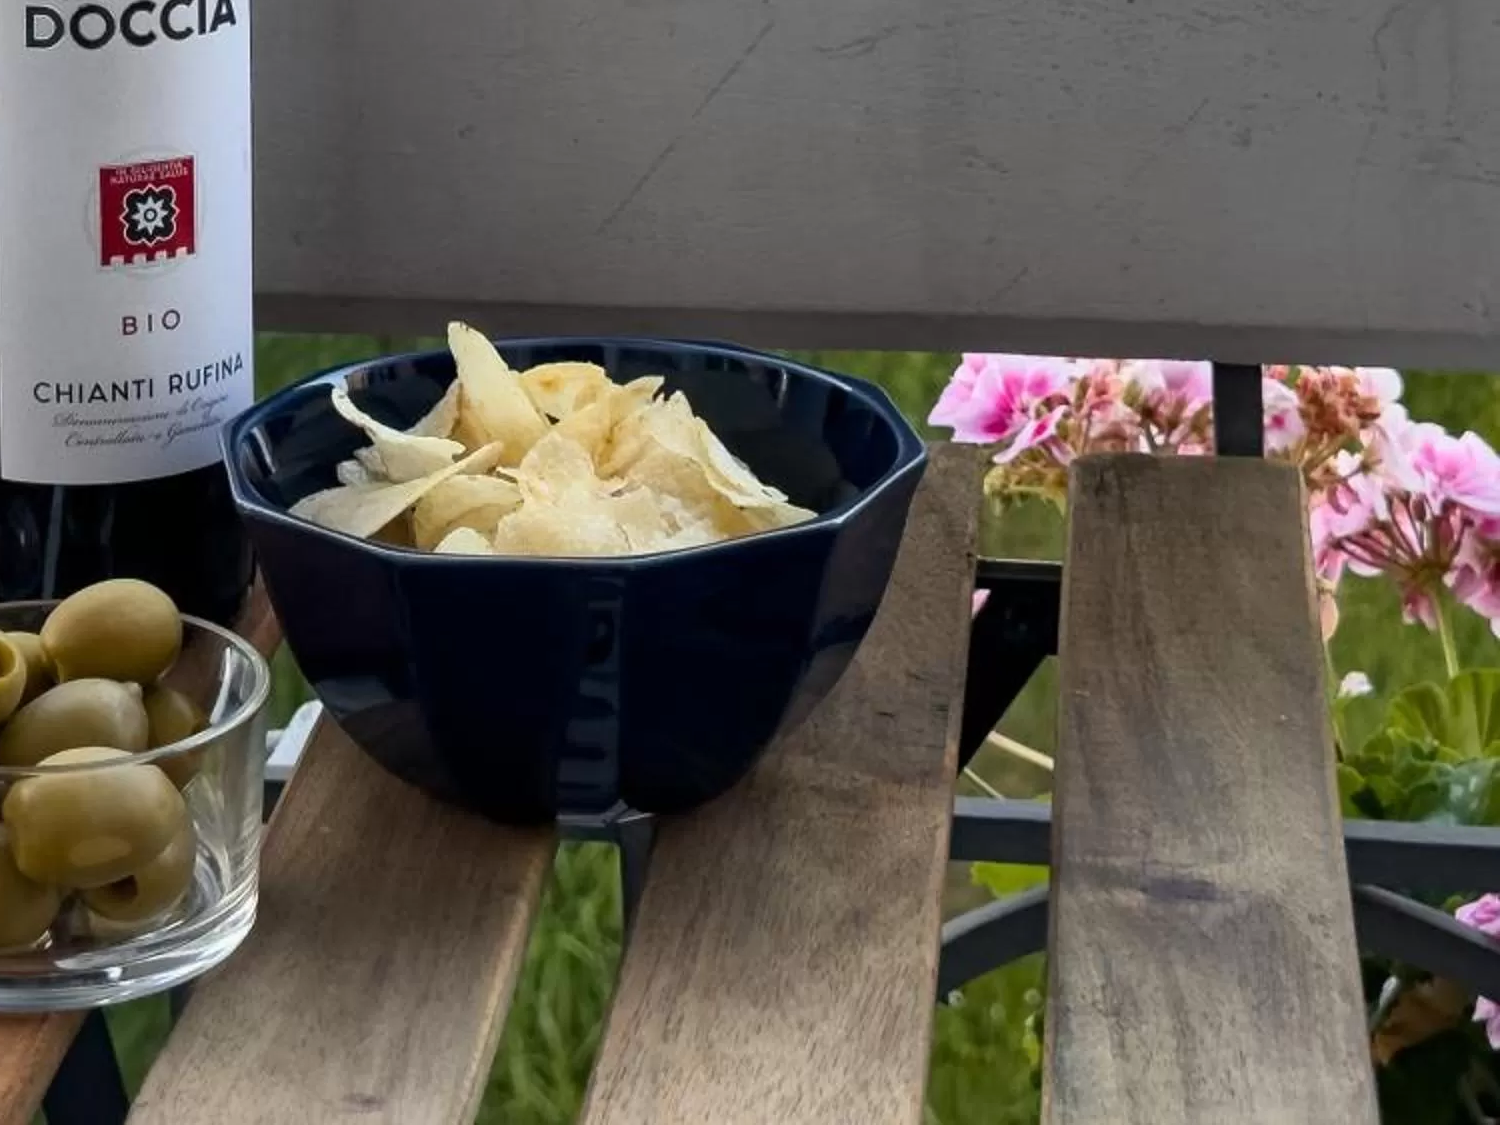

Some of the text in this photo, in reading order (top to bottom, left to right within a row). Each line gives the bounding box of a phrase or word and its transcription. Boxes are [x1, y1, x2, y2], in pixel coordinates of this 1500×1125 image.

[121, 309, 182, 336] BIO
[32, 352, 244, 404] CHIANTI RUFINA
